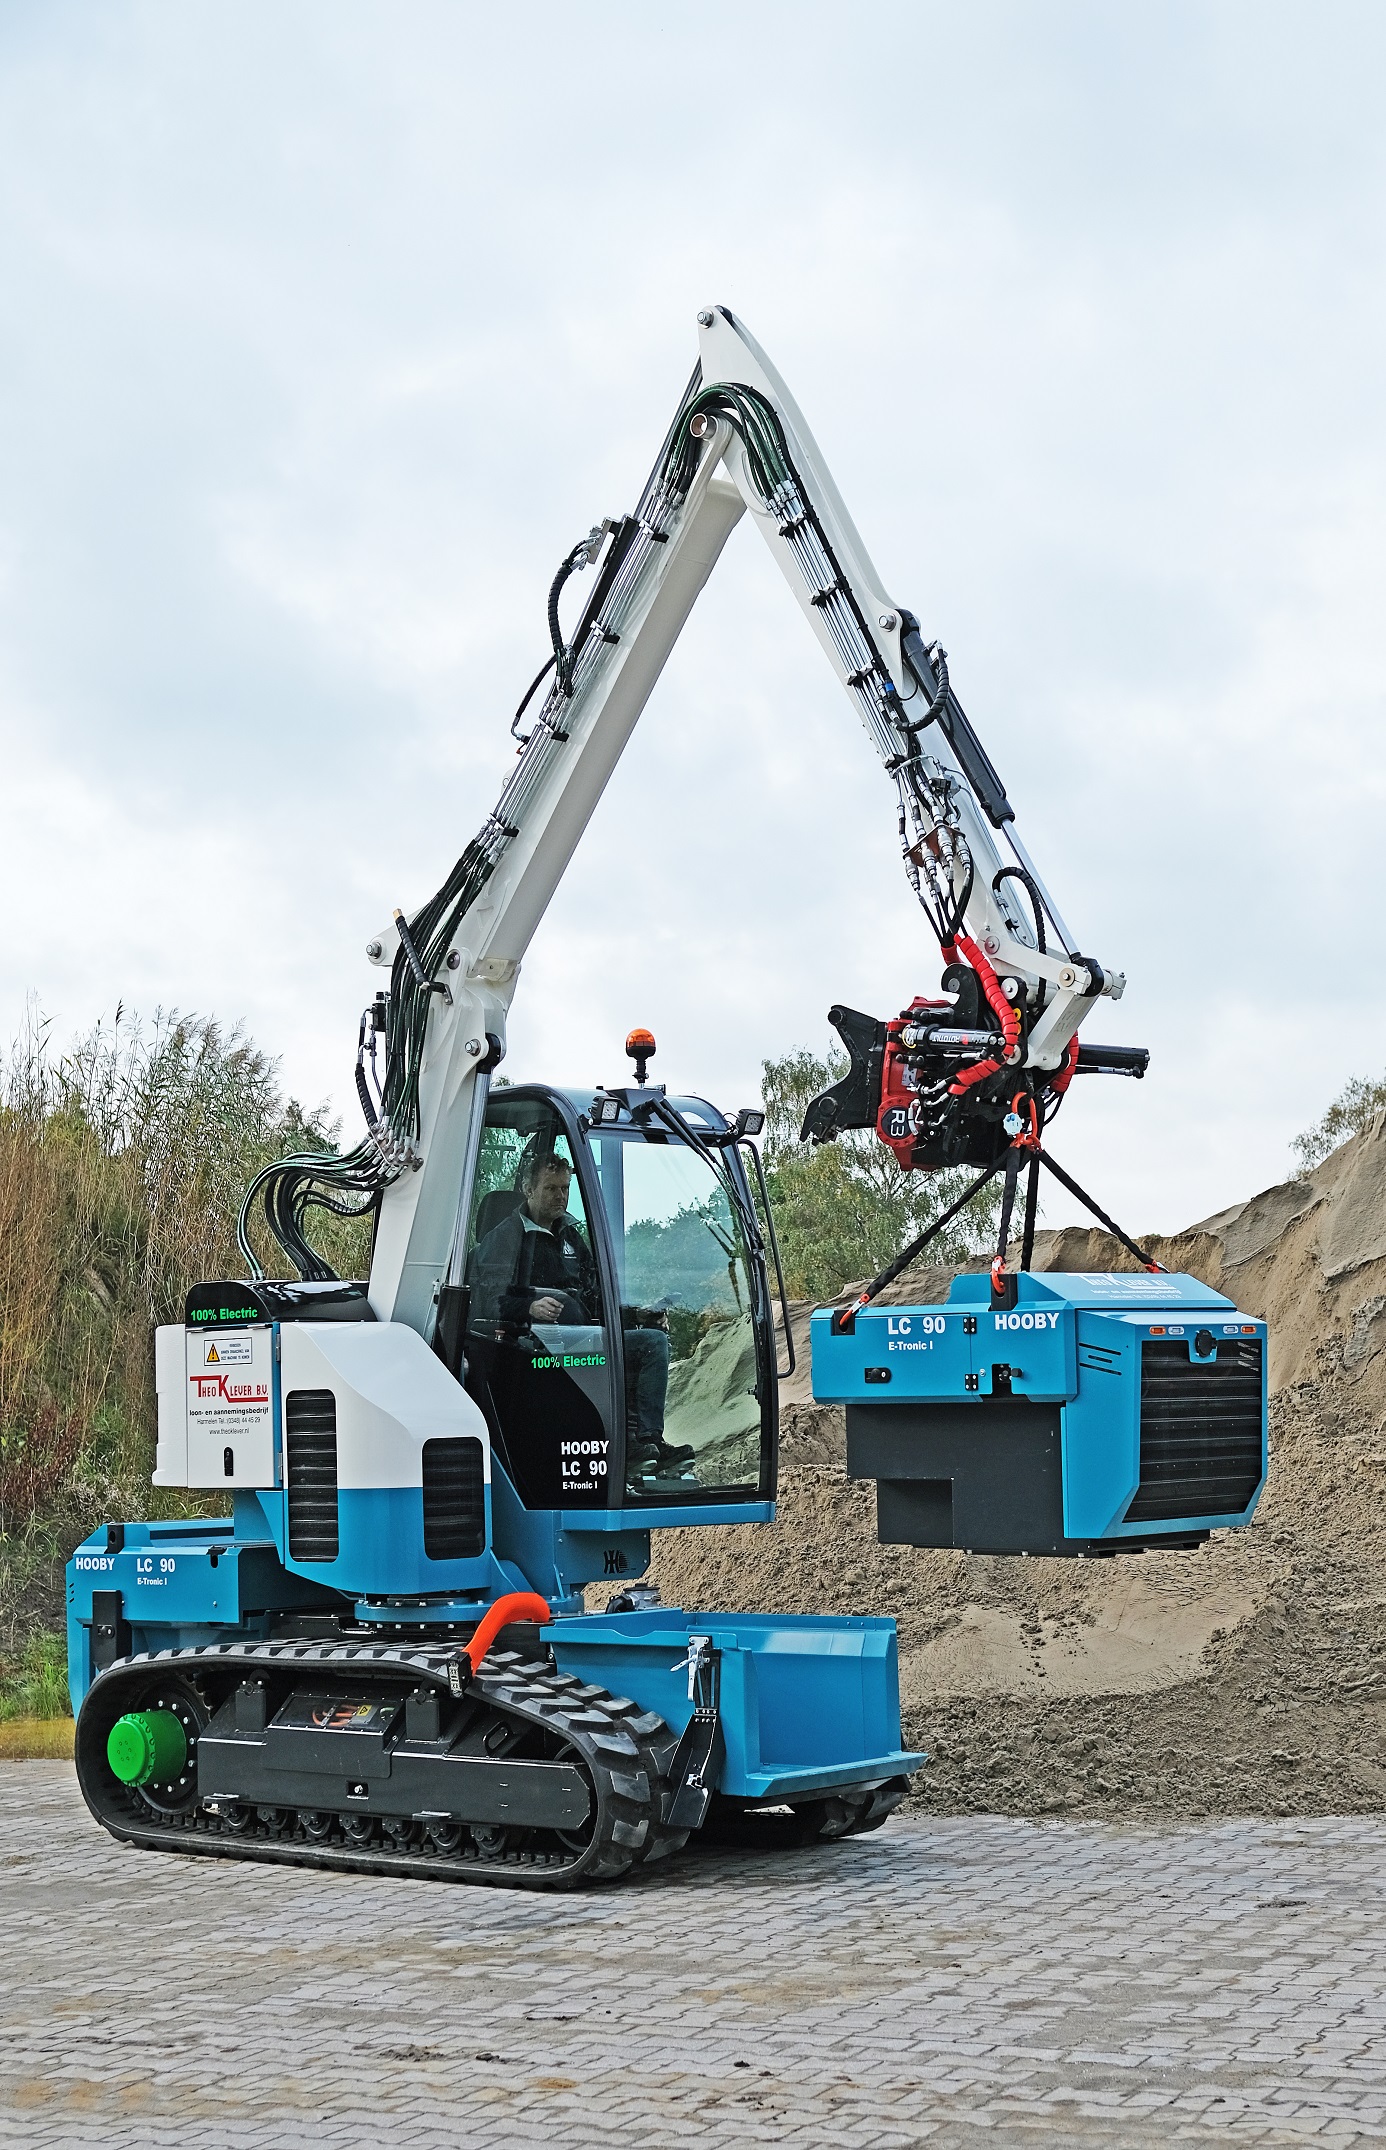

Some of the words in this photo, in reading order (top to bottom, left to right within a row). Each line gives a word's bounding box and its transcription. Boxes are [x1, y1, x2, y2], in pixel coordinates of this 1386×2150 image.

[891, 1110, 905, 1136] R3
[190, 1308, 217, 1321] 100%
[219, 1307, 258, 1320] Electric
[995, 1312, 1059, 1330] HOOBY
[887, 1317, 911, 1335] LC
[922, 1316, 946, 1334] 90
[888, 1342, 927, 1350] E-Tronic
[531, 1356, 560, 1369] 100%
[563, 1354, 606, 1367] Electric
[256, 1384, 269, 1396] B.V.
[561, 1440, 609, 1454] HOOBY
[562, 1461, 580, 1476] LC
[589, 1460, 607, 1476] 90
[562, 1482, 593, 1490] E-Tronic
[75, 1557, 115, 1570] HOOBY
[136, 1558, 153, 1573] LC
[160, 1558, 176, 1573] 90
[137, 1577, 163, 1585] E-Tronic
